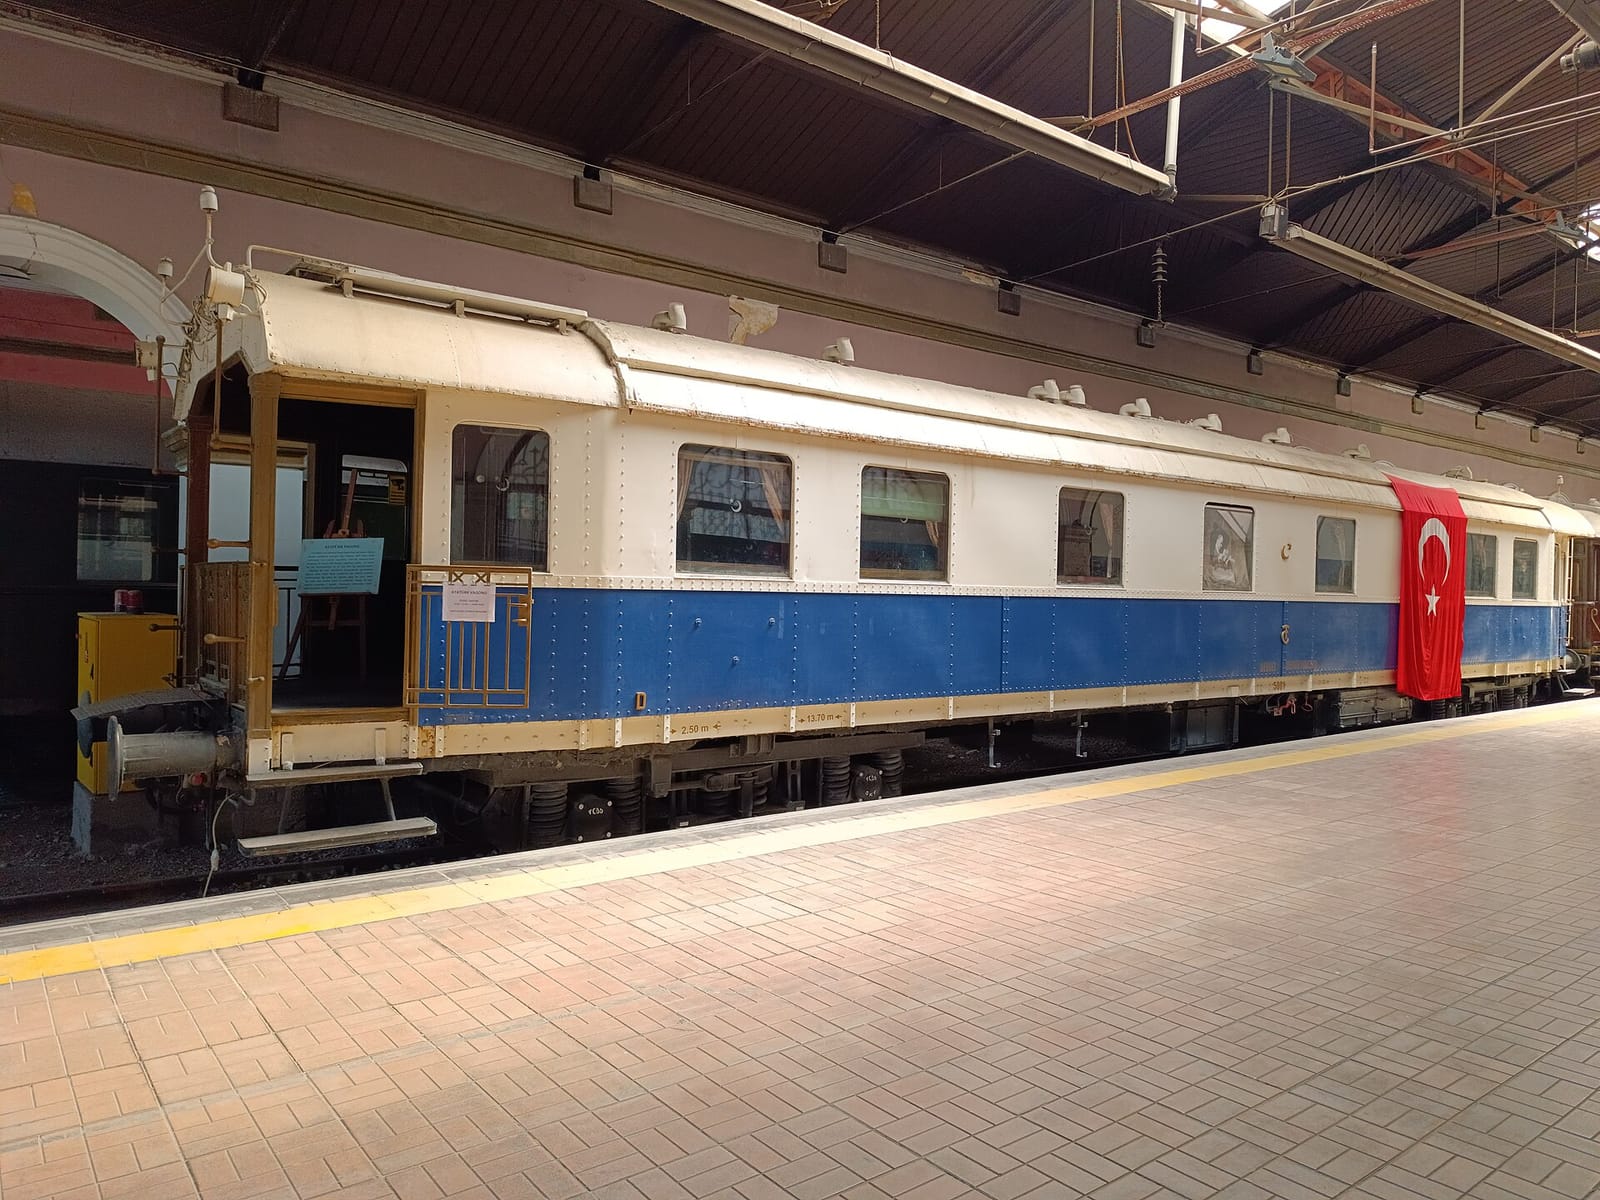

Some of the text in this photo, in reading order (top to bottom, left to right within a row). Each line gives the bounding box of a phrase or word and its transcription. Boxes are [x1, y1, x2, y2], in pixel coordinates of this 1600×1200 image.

[807, 714, 826, 722] 13.70
[682, 724, 708, 734] 2.50 m
